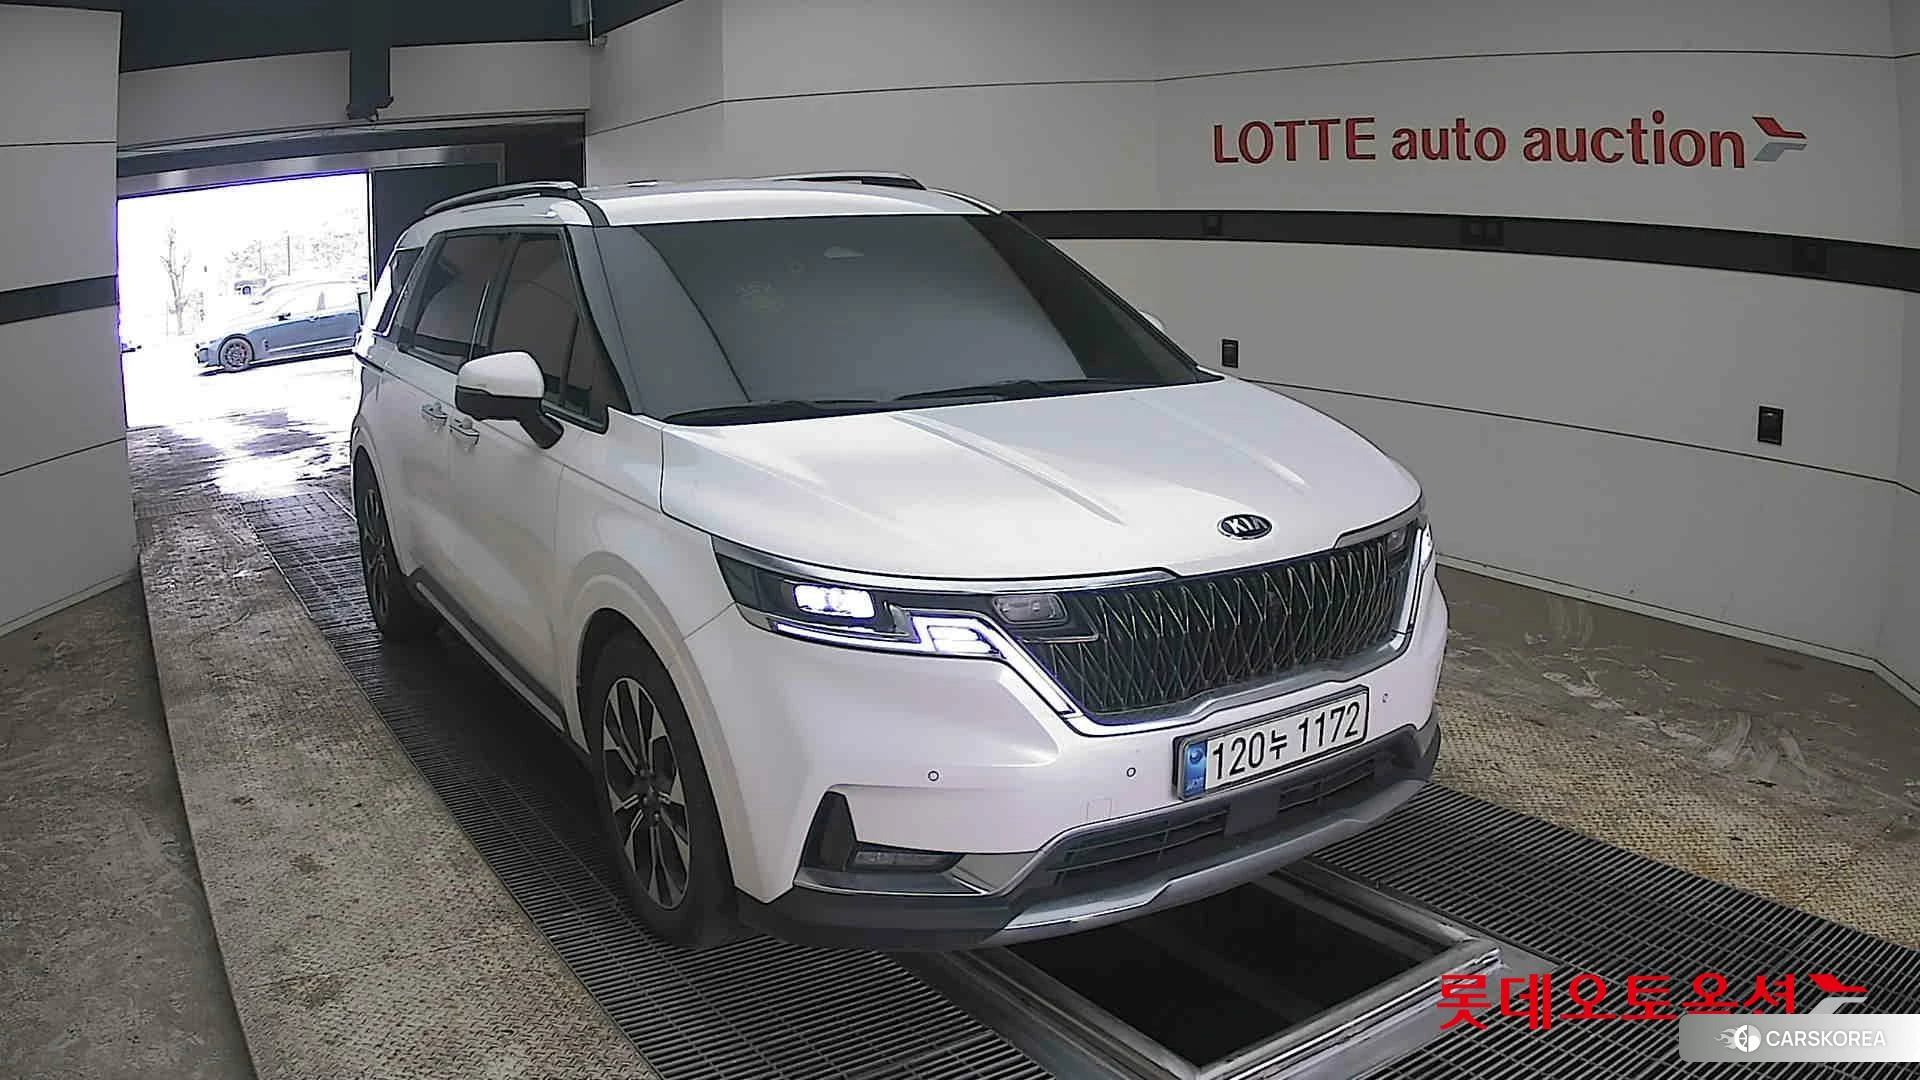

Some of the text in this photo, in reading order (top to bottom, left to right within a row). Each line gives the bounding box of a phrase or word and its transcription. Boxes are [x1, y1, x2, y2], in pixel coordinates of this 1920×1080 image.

[1213, 110, 1746, 169] LOTTE auto auction
[1224, 516, 1269, 534] KIA
[1212, 701, 1361, 780] 120누 1172
